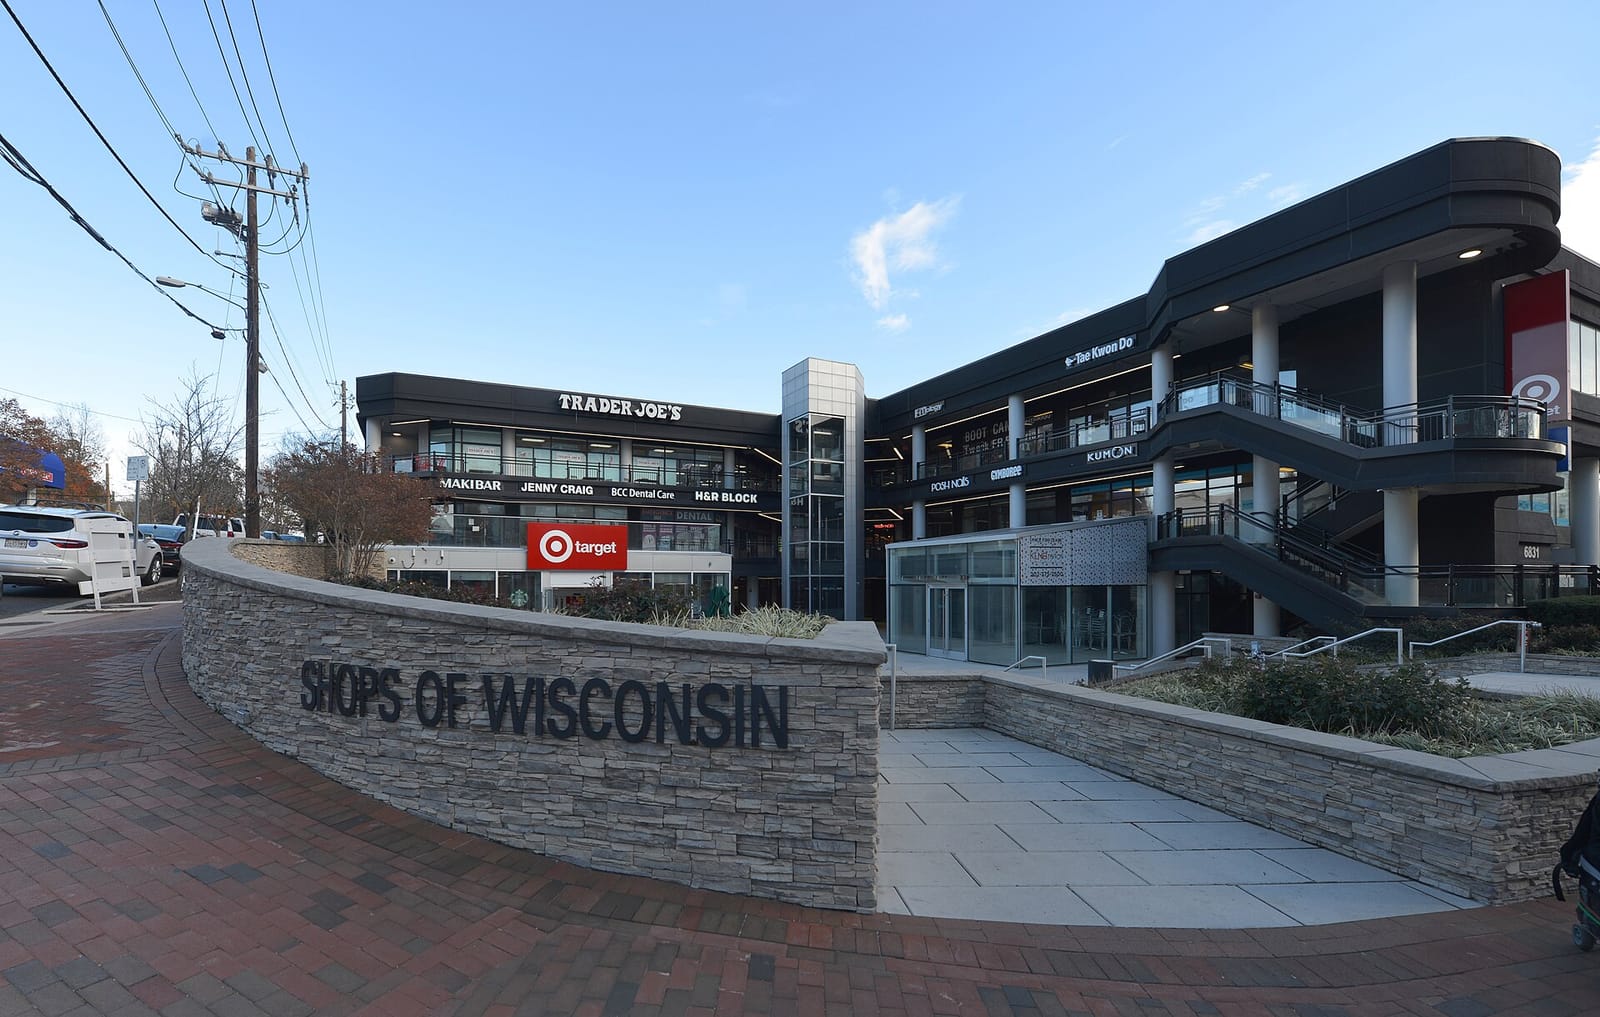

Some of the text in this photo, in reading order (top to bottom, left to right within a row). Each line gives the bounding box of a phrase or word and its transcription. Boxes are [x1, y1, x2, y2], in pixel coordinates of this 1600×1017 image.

[1075, 337, 1133, 365] Tae Kwon Do
[559, 394, 682, 421] TRADER JOE'S
[965, 426, 986, 442] BOOT
[1087, 446, 1132, 462] KUMON
[439, 478, 502, 491] MAKI BAR
[520, 482, 594, 496] JENNY CRAIG
[931, 480, 951, 492] POSH
[611, 487, 675, 500] BCC Dental Care
[695, 490, 758, 504] H&R BLOCK
[676, 511, 712, 521] DENTAL
[574, 541, 617, 556] target
[1523, 545, 1540, 559] 6831
[300, 660, 789, 749] SHOPS OF WISCONSIN
